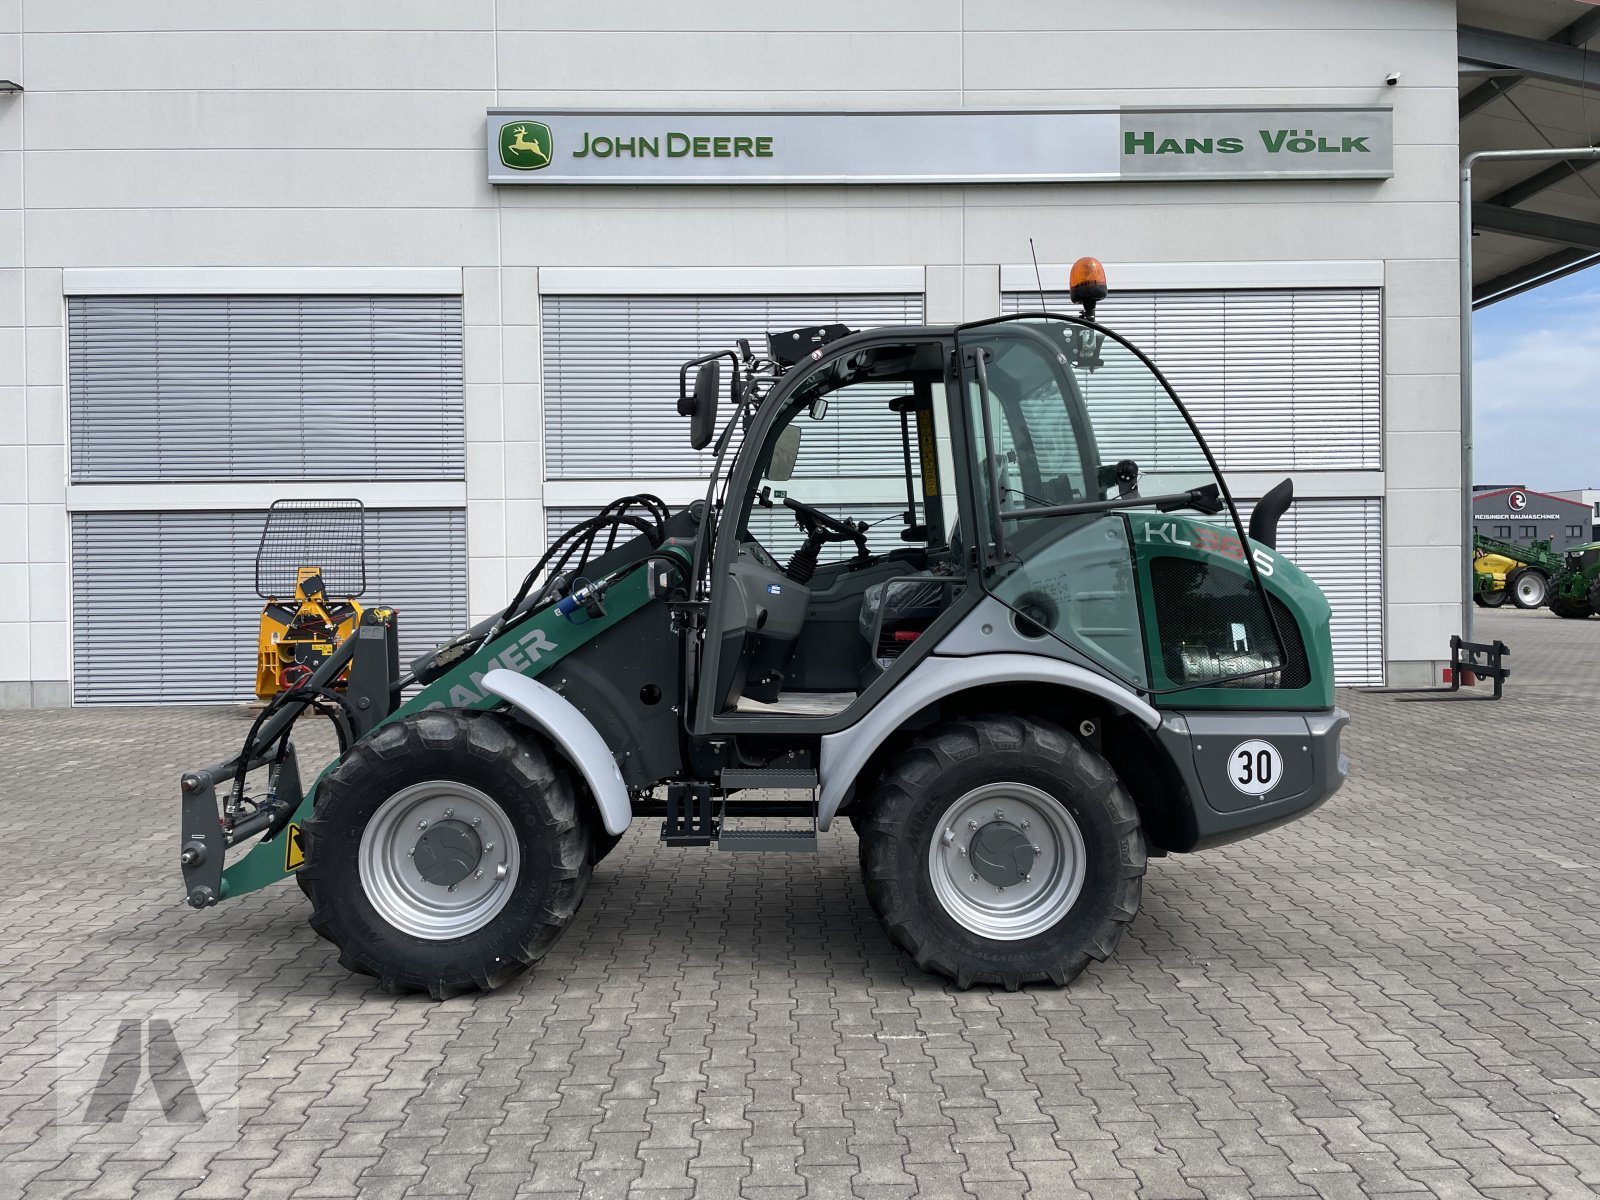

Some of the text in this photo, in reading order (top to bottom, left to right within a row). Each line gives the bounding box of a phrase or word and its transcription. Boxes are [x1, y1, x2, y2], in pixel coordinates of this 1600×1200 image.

[573, 132, 774, 158] JOHN DEERE
[1124, 129, 1372, 155] HANS VÖLK
[1238, 750, 1272, 785] 30
